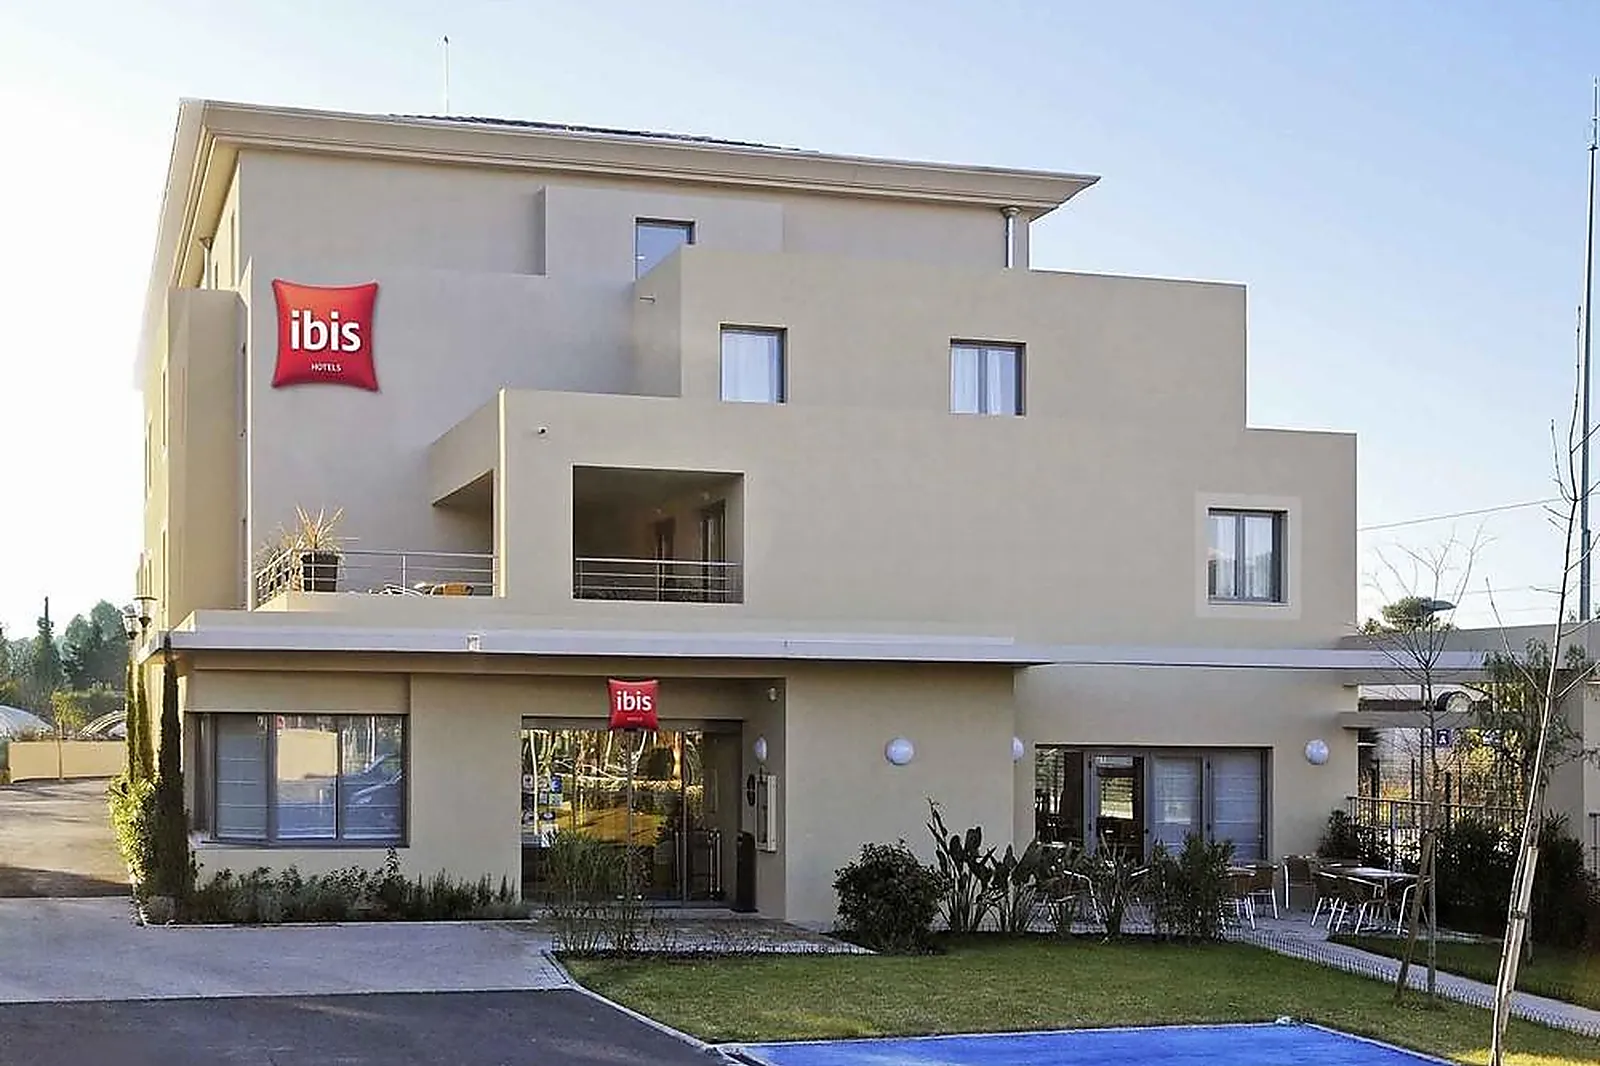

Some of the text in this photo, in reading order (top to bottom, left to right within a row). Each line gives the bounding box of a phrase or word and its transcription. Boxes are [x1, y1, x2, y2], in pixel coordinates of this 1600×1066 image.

[291, 310, 361, 352] ibis
[311, 363, 342, 372] HOTELS
[616, 690, 653, 711] ibis
